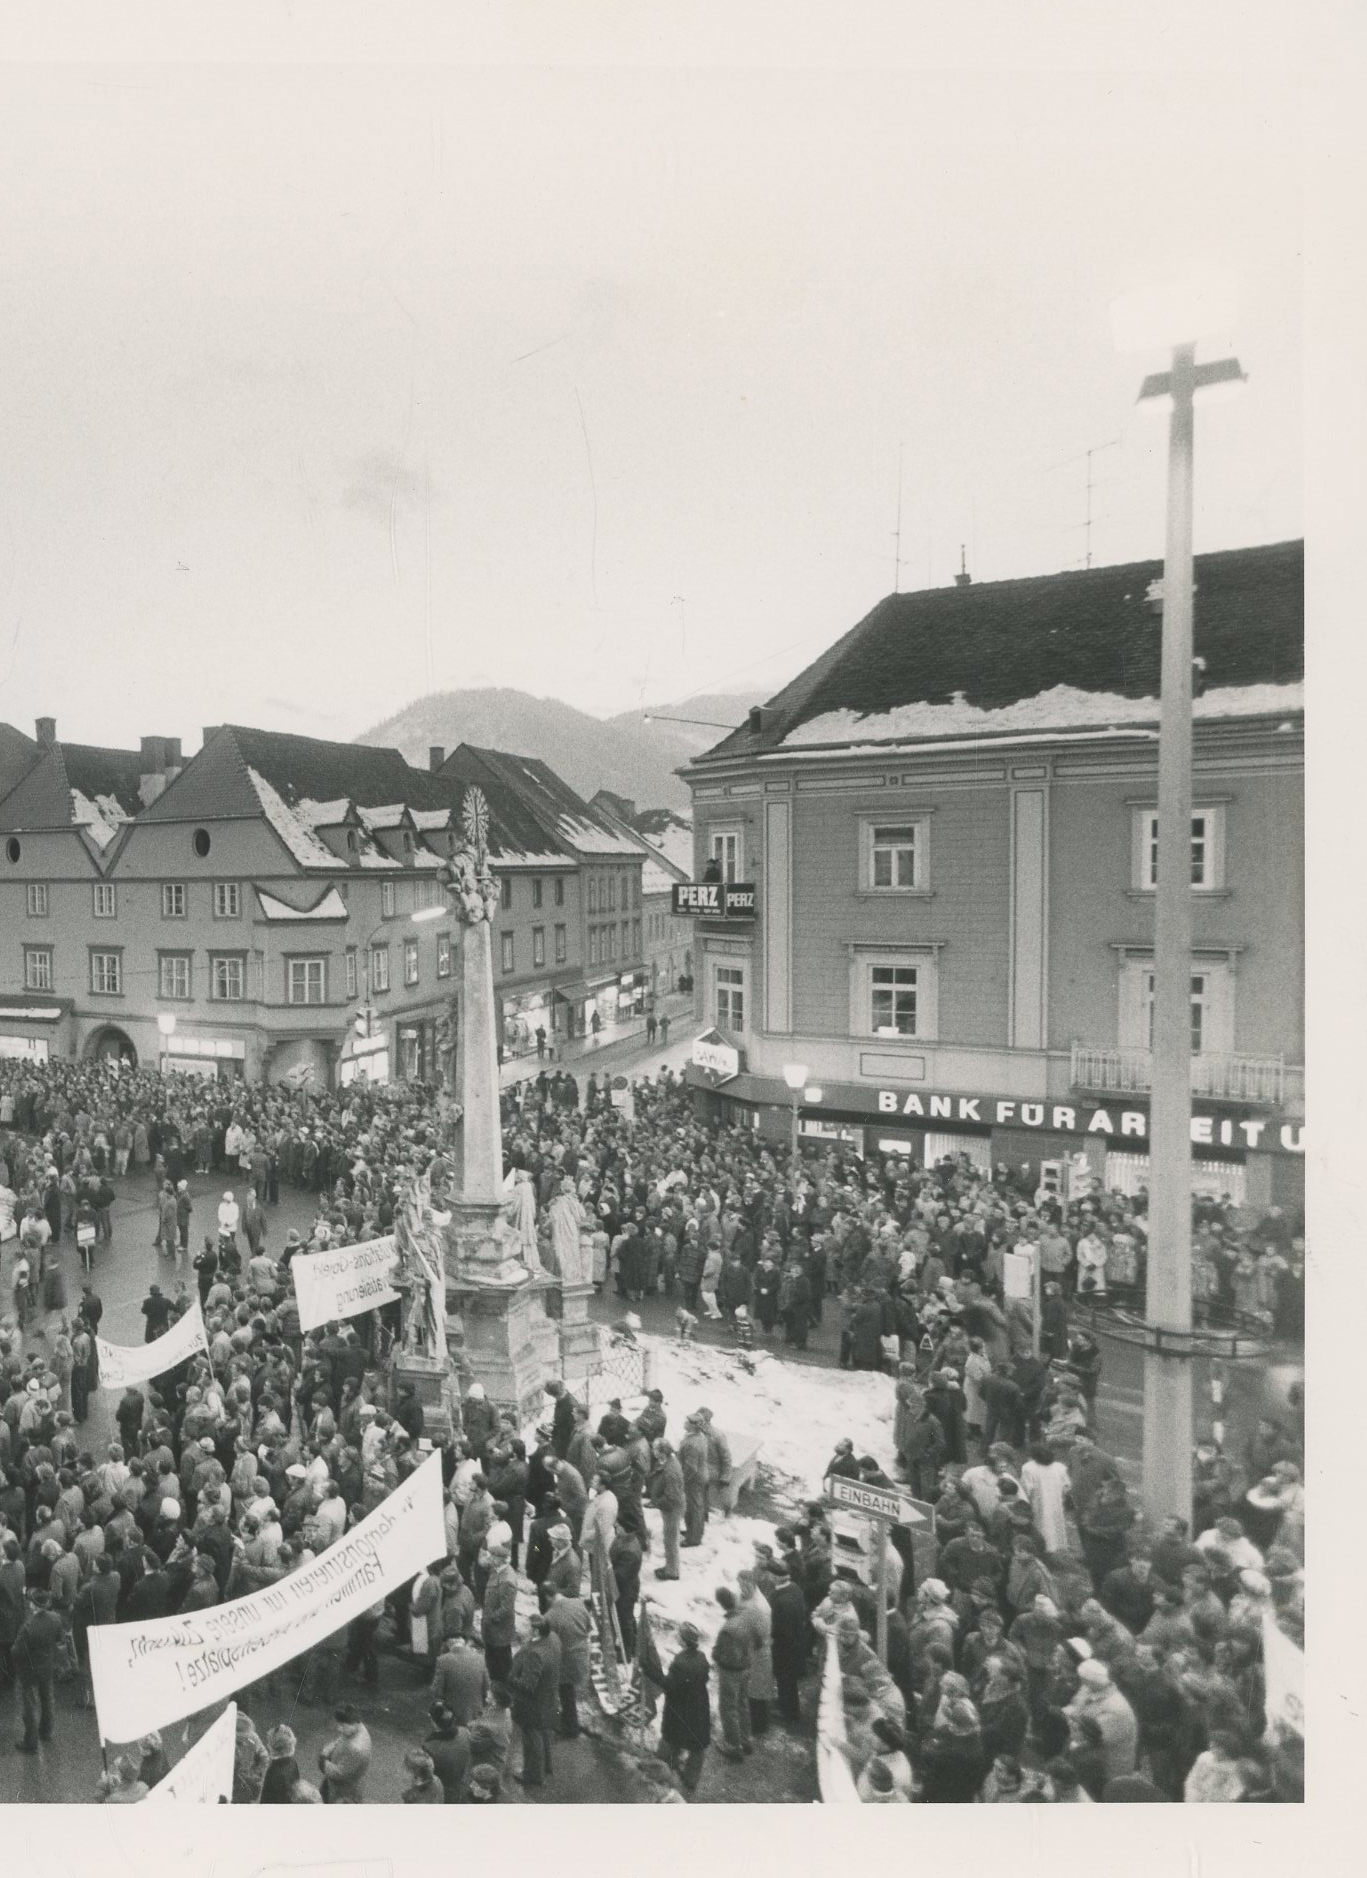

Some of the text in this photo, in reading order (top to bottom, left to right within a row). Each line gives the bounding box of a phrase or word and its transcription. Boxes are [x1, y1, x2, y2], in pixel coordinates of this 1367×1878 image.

[678, 886, 719, 907] PERZ
[727, 893, 754, 907] PERZ
[878, 1090, 980, 1122] BANK
[996, 1100, 1076, 1133] FÜR
[1088, 1108, 1265, 1149] AREIT
[840, 1486, 901, 1516] EINBAHN
